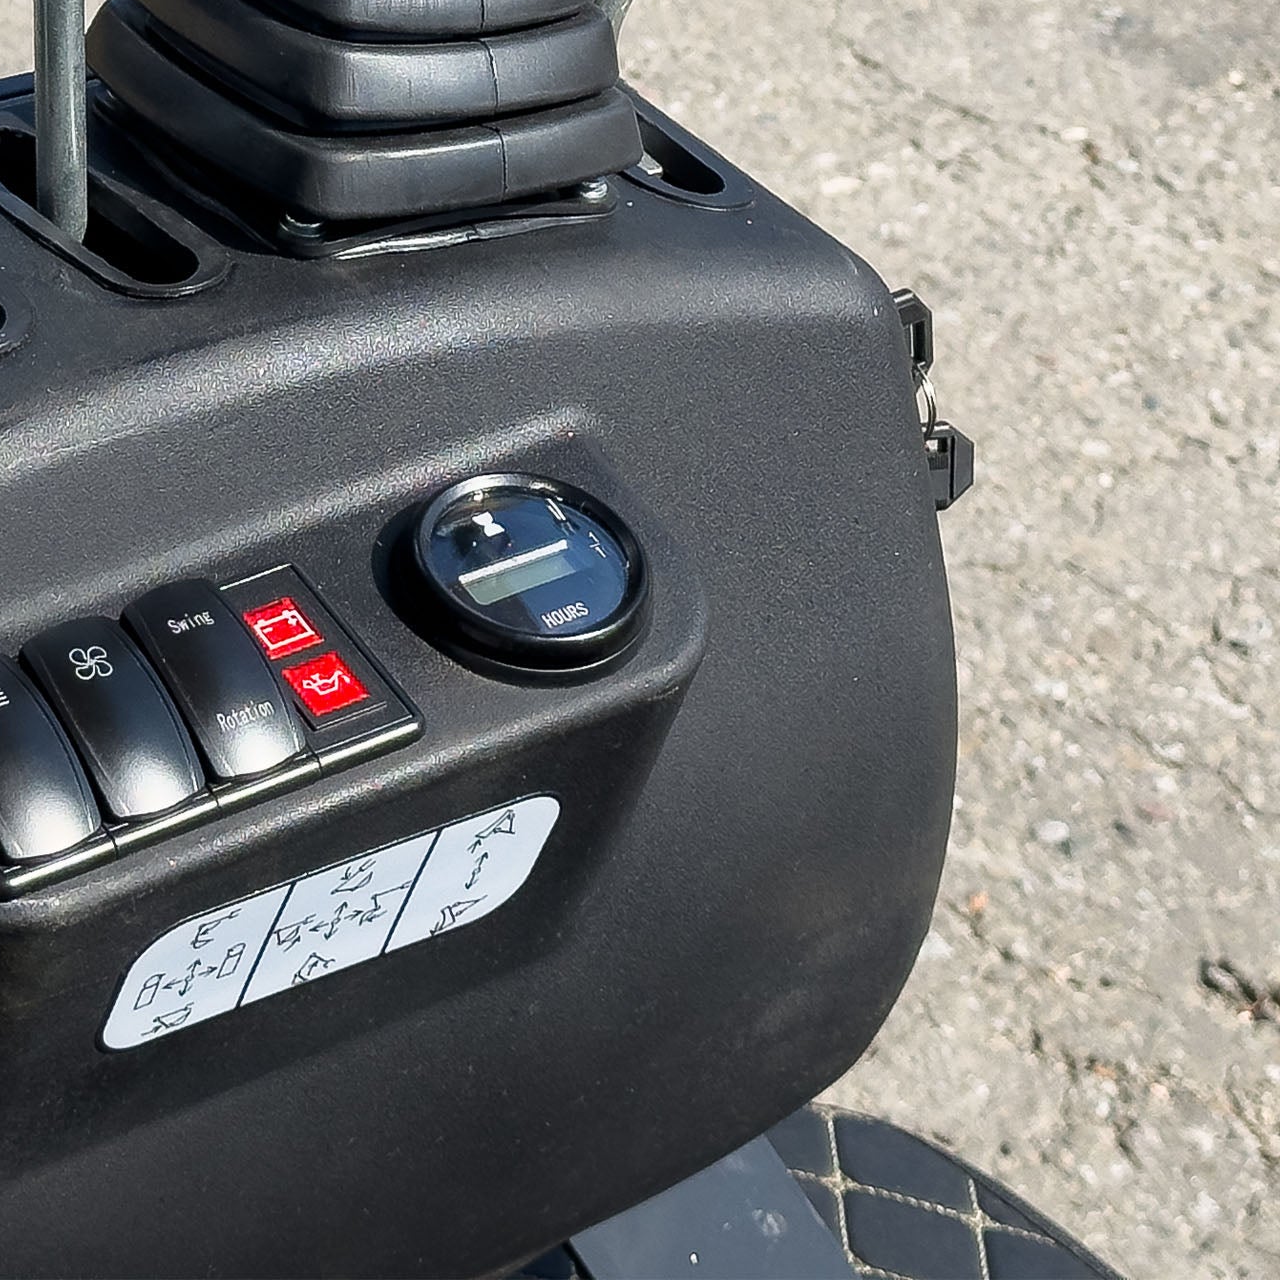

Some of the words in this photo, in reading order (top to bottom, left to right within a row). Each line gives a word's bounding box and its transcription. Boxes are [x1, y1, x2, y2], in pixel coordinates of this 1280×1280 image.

[167, 610, 215, 634] Swing
[542, 602, 589, 629] HOURS
[216, 701, 275, 732] Rotation
